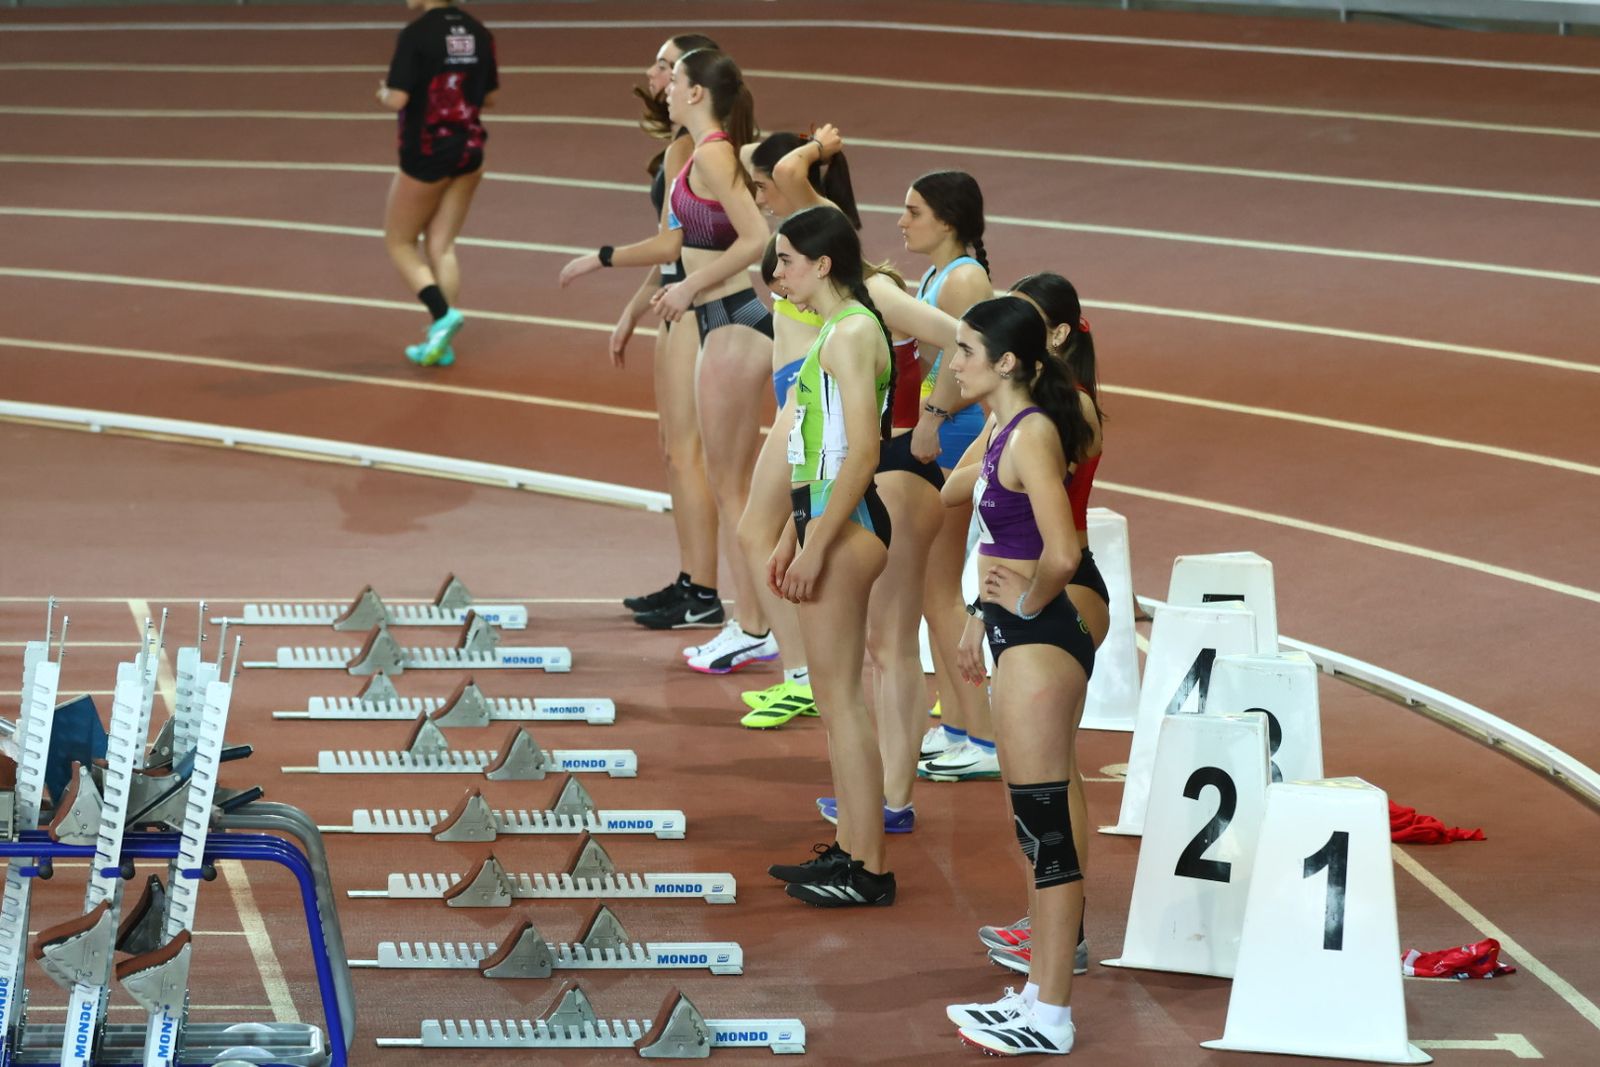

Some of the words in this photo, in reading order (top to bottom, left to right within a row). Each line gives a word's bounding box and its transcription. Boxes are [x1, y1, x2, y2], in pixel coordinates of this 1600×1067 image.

[501, 656, 544, 665] MONDO
[1165, 647, 1217, 714] 4
[549, 706, 585, 714] MONDO
[561, 758, 608, 769] MONDO
[607, 819, 655, 829] MONDO
[1174, 767, 1238, 883] 2
[655, 883, 704, 893] MONDO
[1302, 831, 1349, 951] 1
[656, 954, 709, 965] MONDO
[75, 1000, 92, 1058] MONDO
[715, 1031, 769, 1042] MONDO
